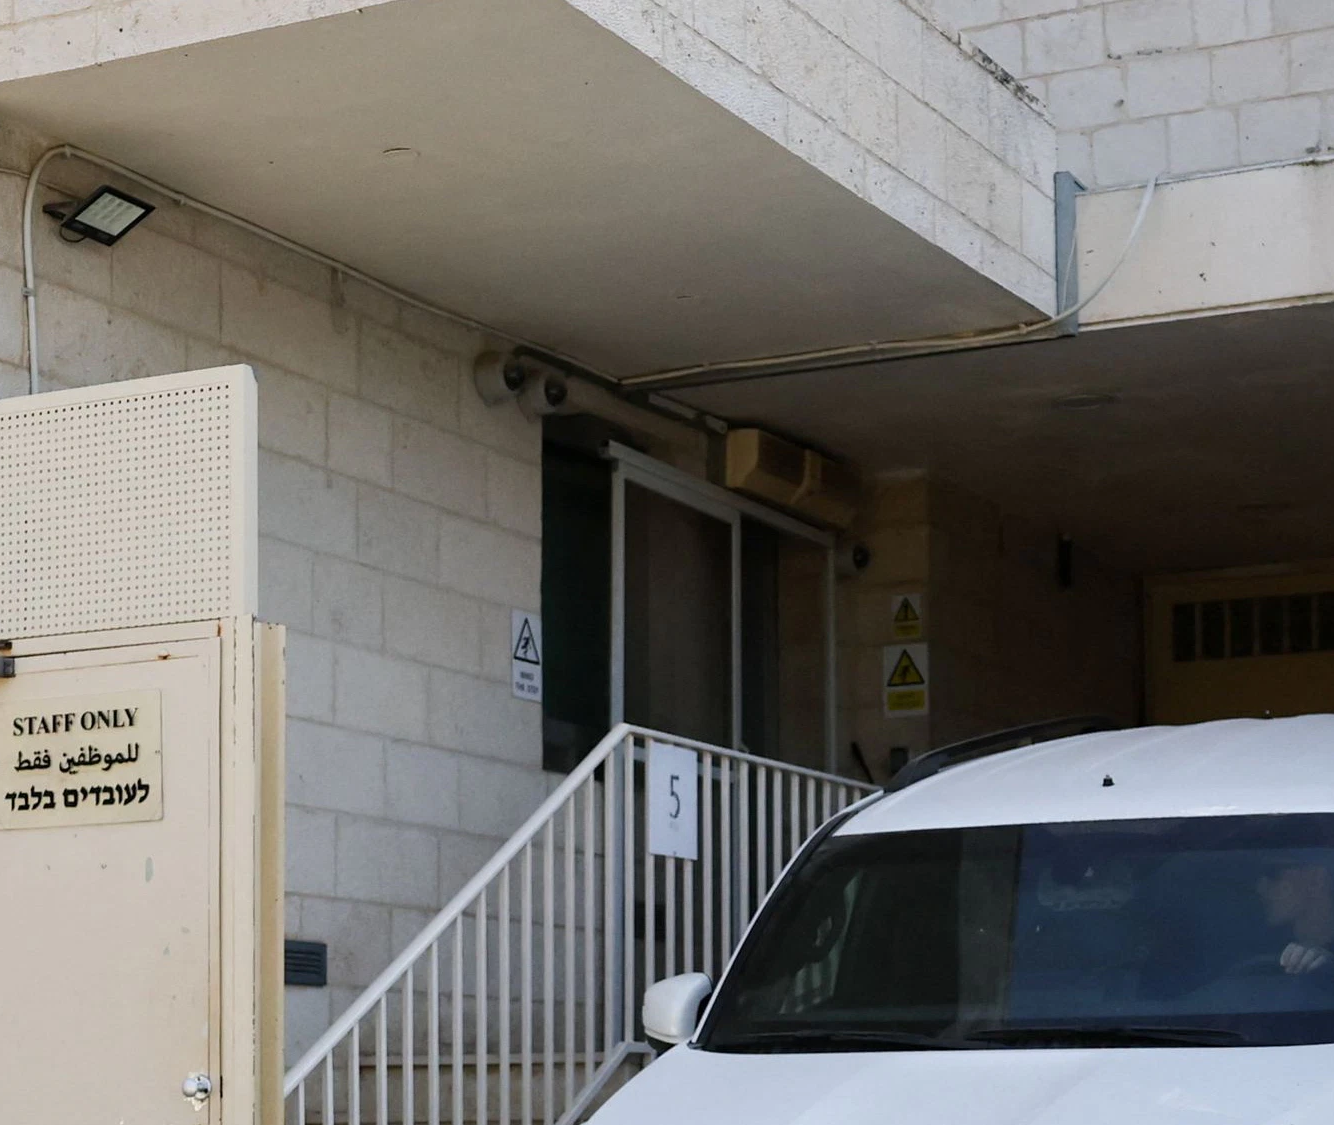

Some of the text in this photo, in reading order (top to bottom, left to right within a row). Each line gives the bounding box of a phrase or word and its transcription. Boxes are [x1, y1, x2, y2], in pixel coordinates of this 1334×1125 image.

[12, 707, 139, 737] STAFF ONLY
[14, 742, 140, 775] للموظفين فقط
[5, 778, 150, 811] לעובדים בלבד
[669, 774, 681, 819] 5
